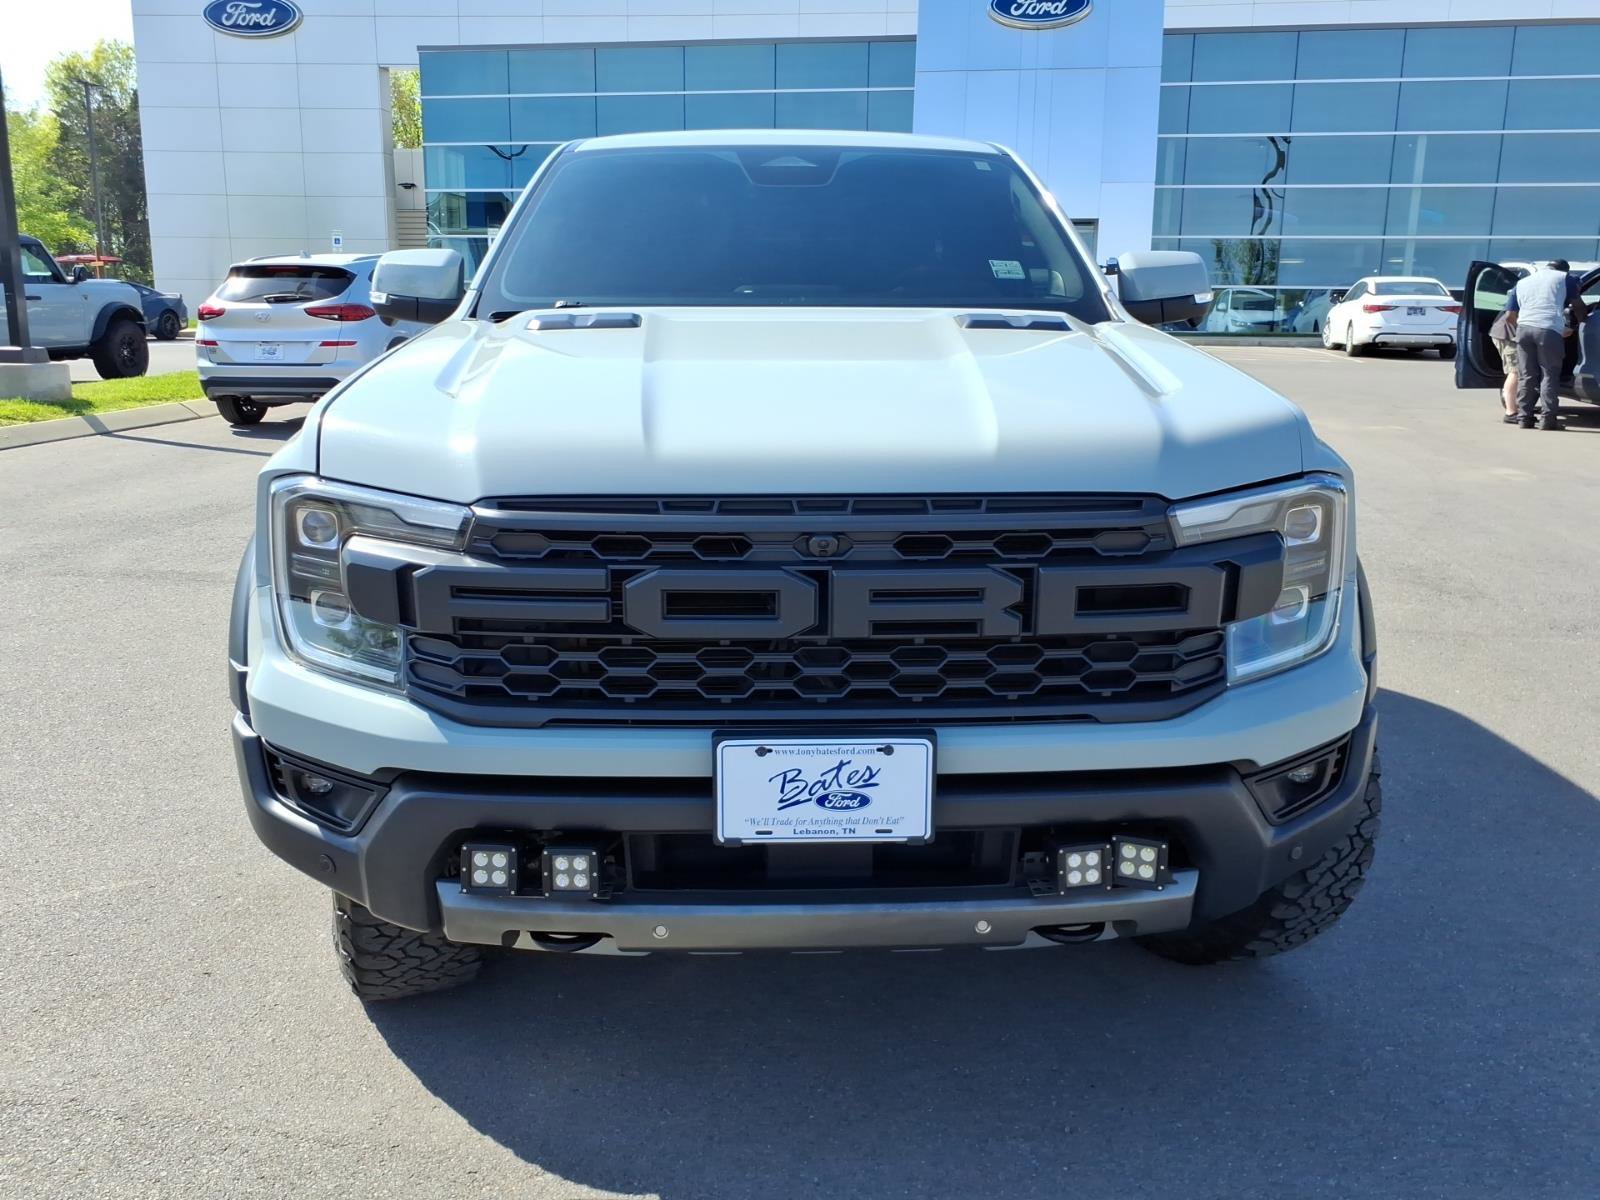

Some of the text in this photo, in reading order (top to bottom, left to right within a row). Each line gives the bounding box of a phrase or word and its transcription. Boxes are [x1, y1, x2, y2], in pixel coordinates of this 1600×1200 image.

[221, 1, 277, 26] Ford
[1010, 0, 1067, 16] Ford
[412, 562, 1227, 640] FORD
[774, 747, 876, 757] www.tonybatesford.com
[768, 759, 882, 804] Bates
[824, 792, 861, 808] Ford
[771, 816, 793, 826] Trade
[793, 816, 808, 827] for
[808, 816, 844, 828] Anything
[845, 816, 861, 825] that
[793, 827, 856, 836] Lebanon, TN
